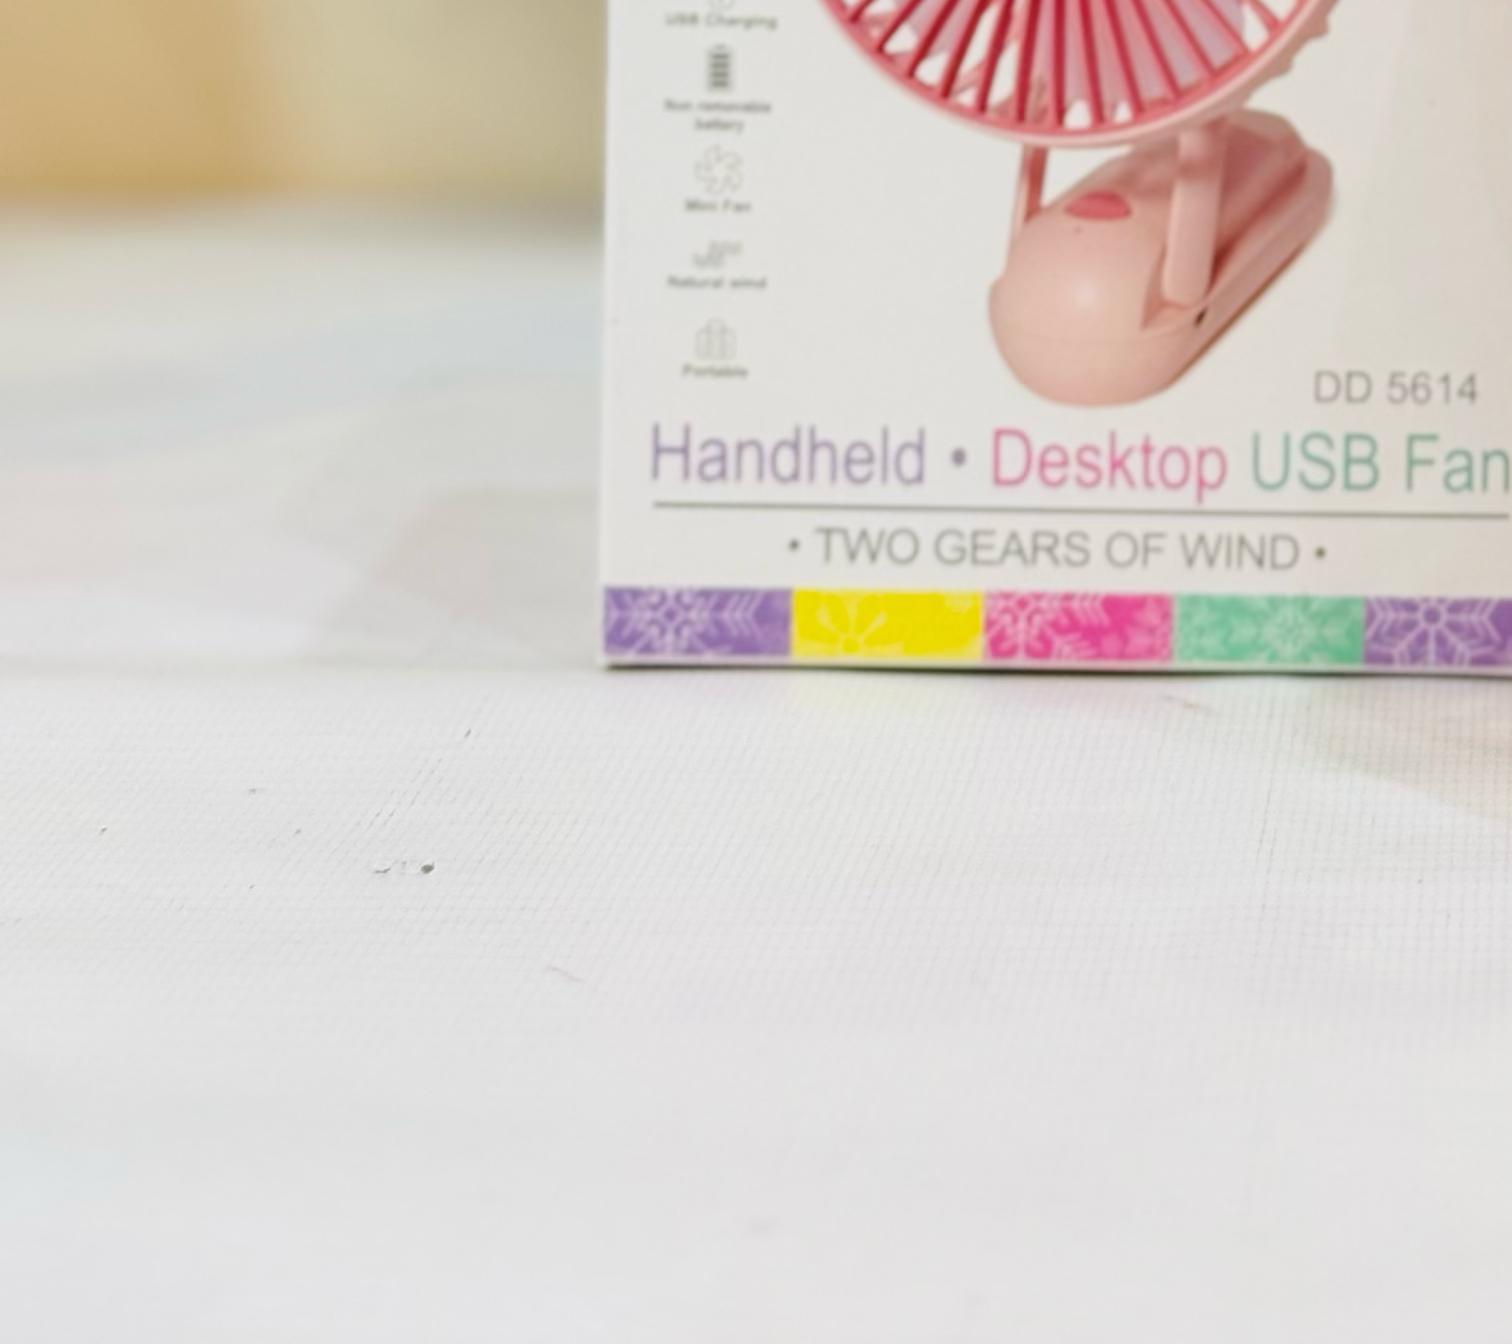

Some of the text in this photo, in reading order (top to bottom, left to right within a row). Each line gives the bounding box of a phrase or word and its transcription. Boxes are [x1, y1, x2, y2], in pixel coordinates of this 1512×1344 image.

[1313, 370, 1478, 405] DD 5614
[651, 423, 1512, 504] Handheld Desktop USB Fan
[814, 527, 1301, 571] TWO GEARS OF WIND
